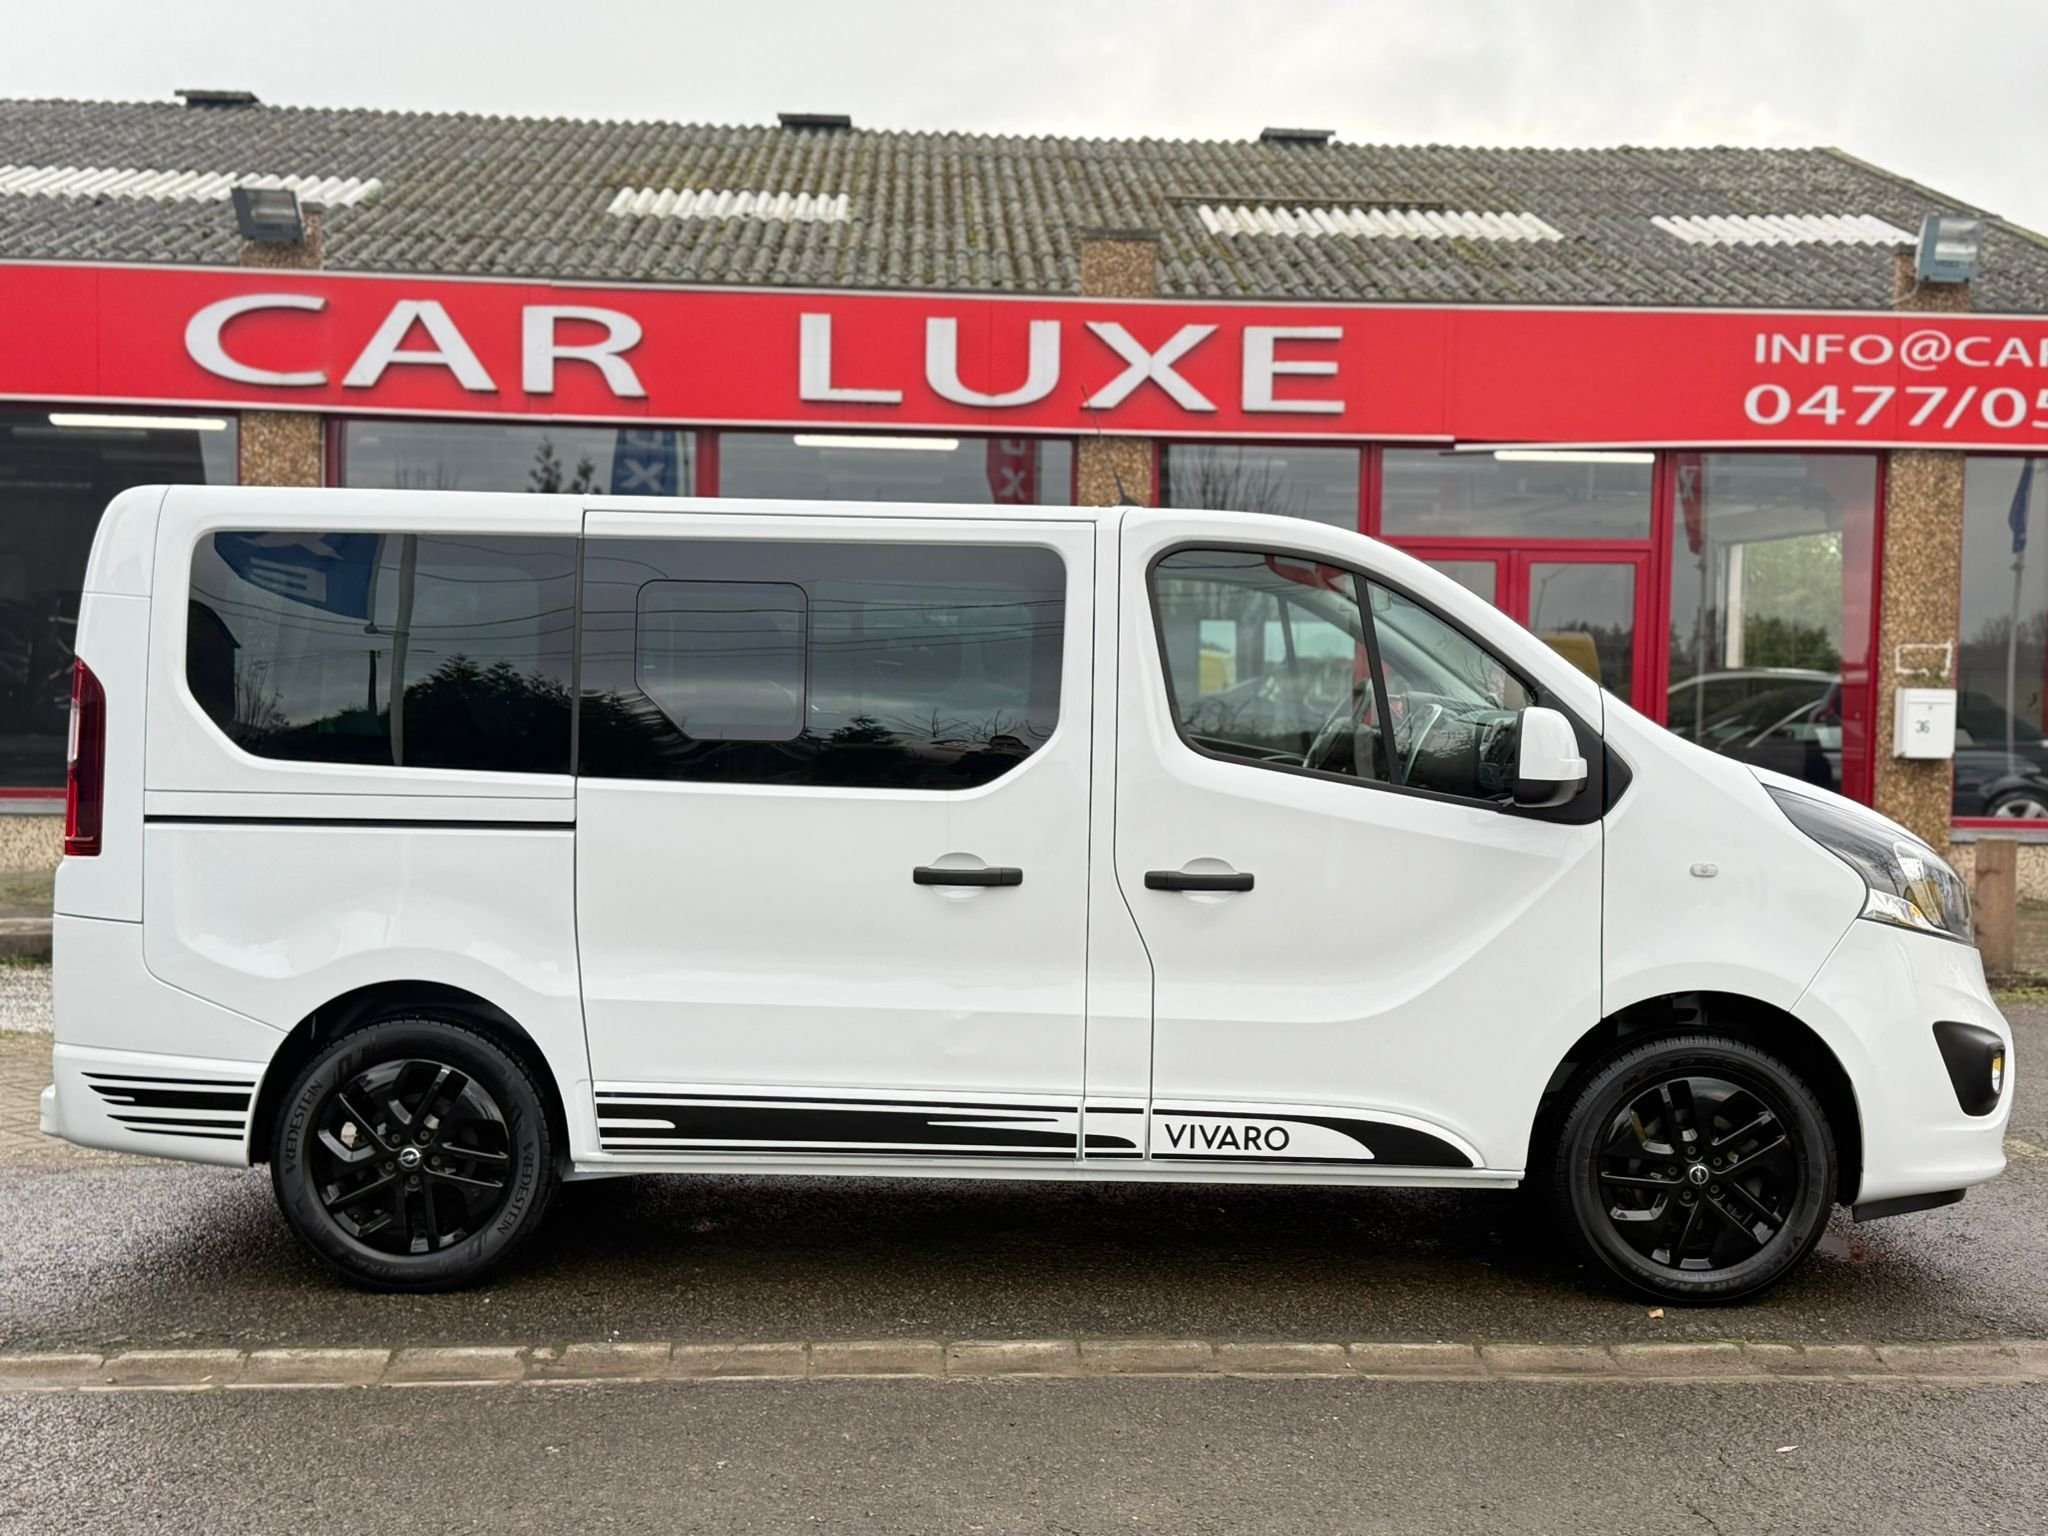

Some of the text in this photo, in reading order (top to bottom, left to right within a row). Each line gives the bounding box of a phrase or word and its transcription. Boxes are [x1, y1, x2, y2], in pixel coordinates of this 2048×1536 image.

[184, 293, 1346, 414] CAR LUXE
[1754, 329, 2048, 370] INFO@CA
[1164, 1123, 1290, 1151] VIVARO
